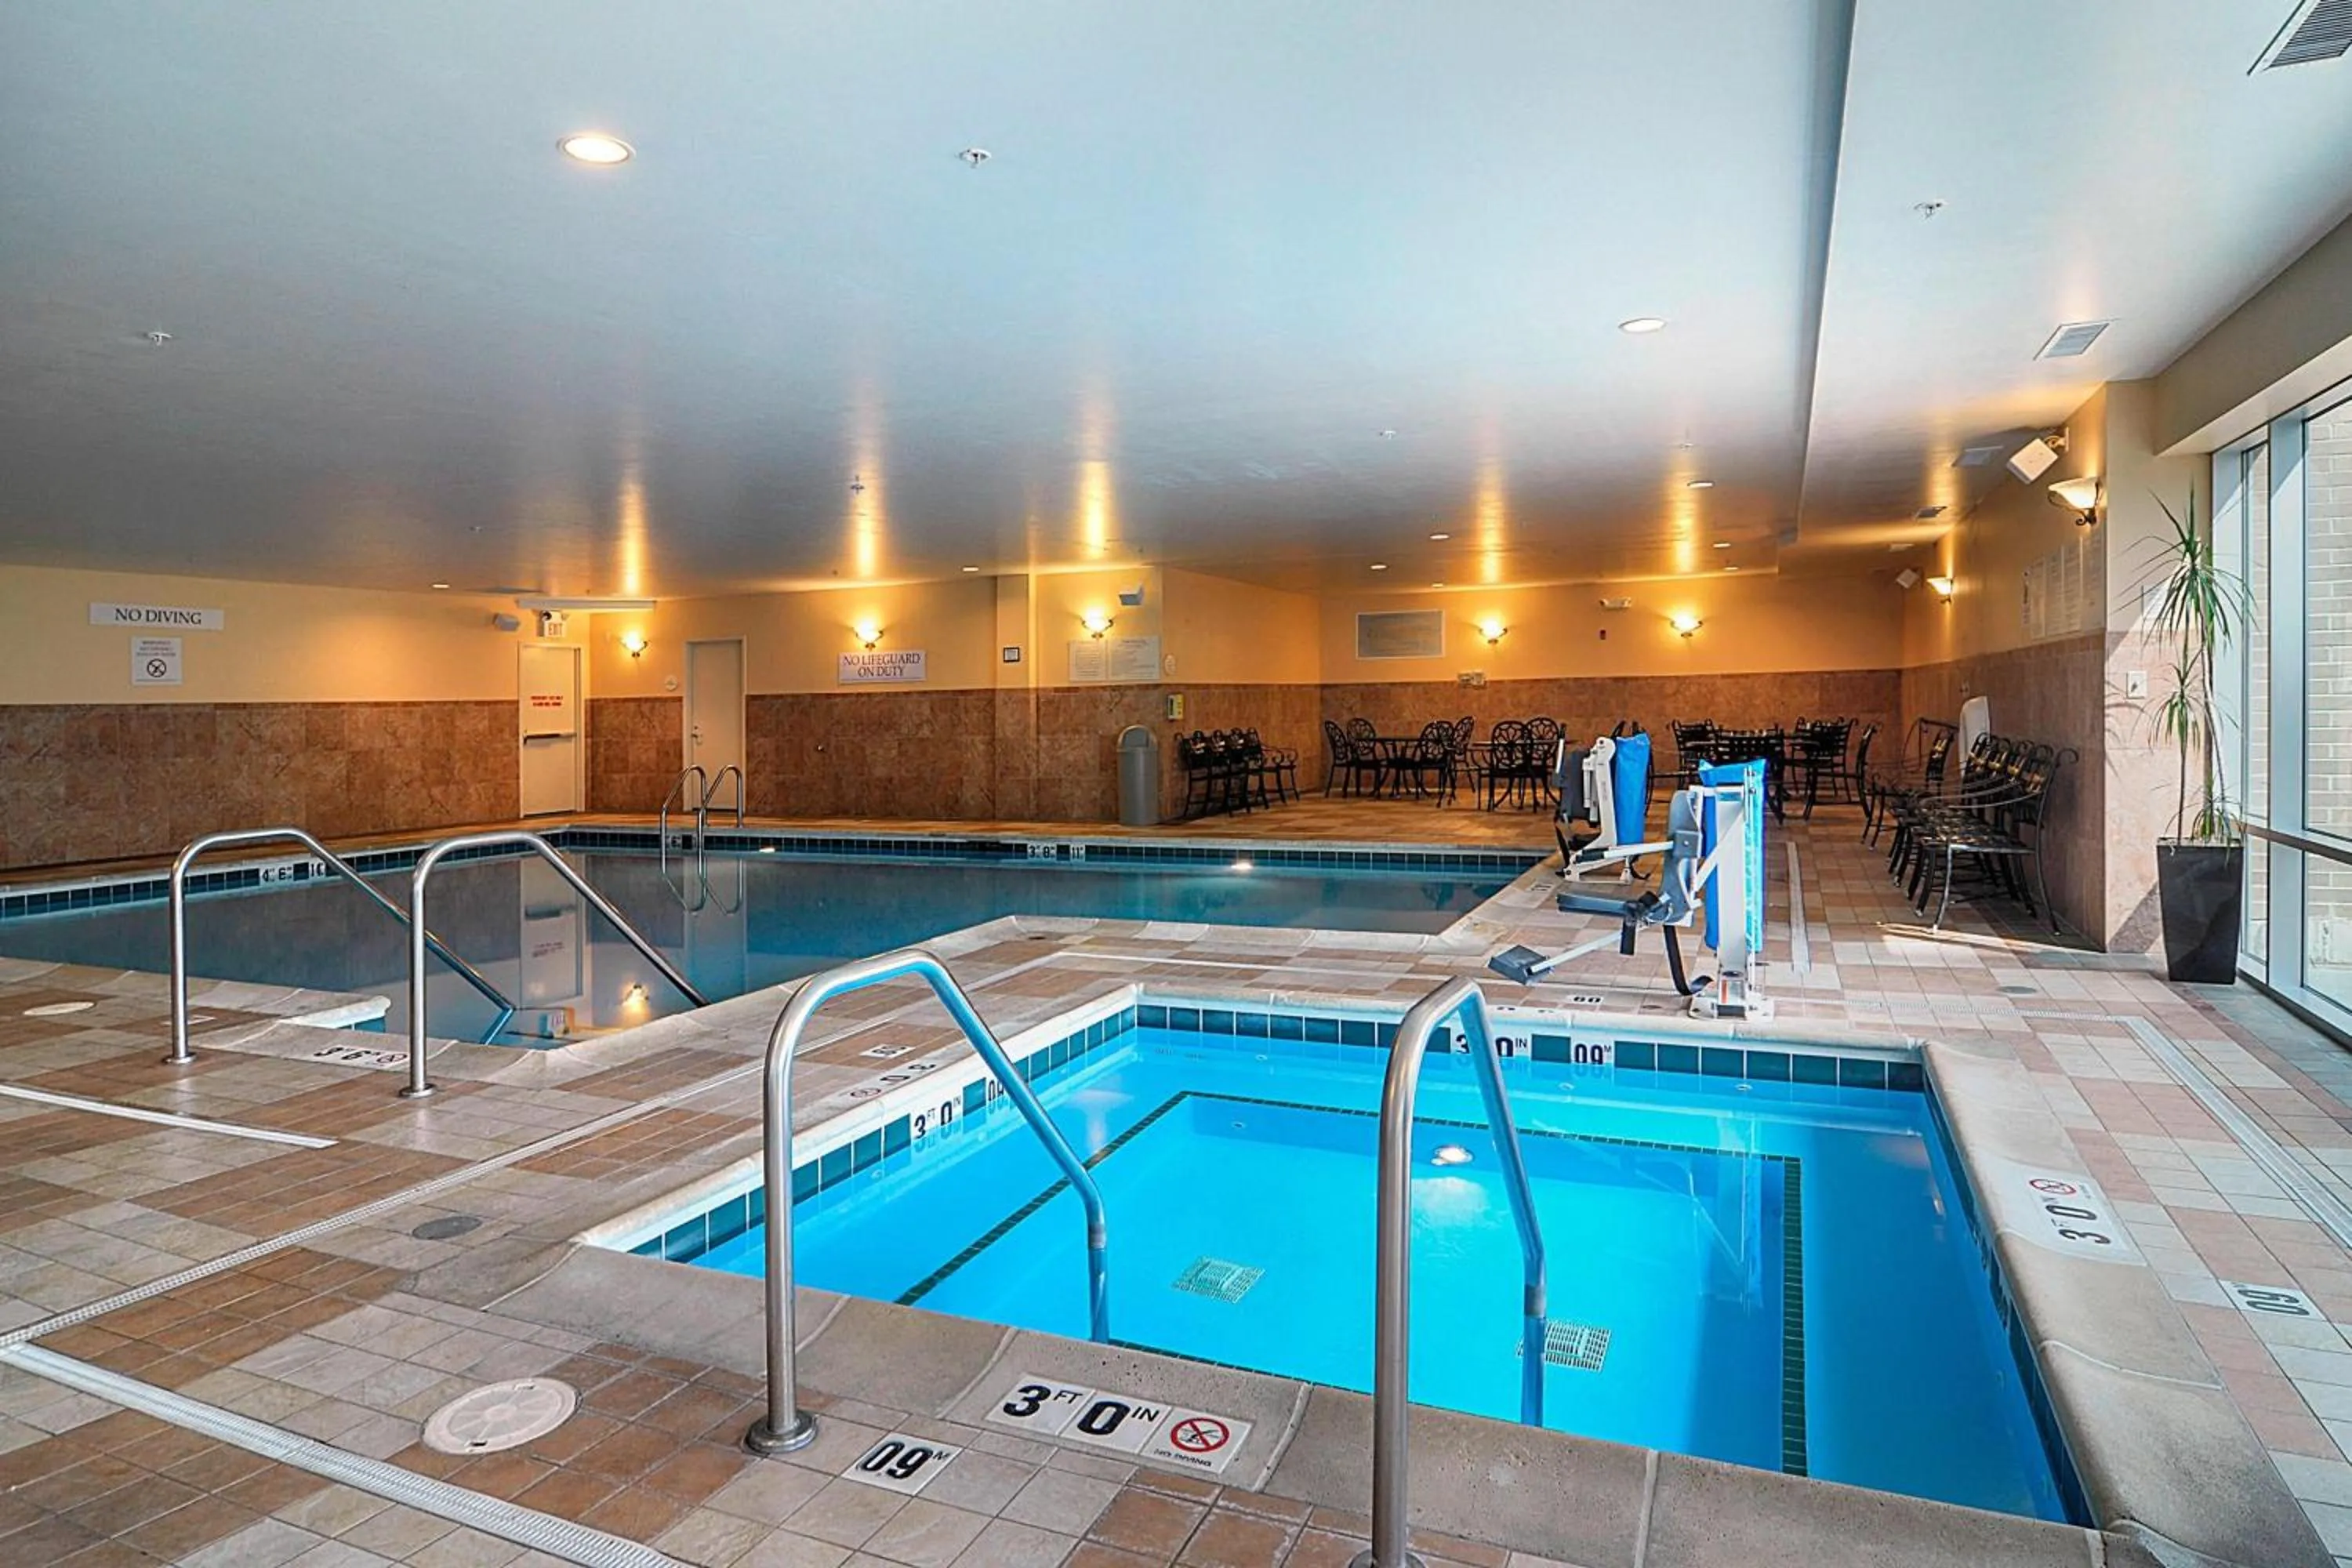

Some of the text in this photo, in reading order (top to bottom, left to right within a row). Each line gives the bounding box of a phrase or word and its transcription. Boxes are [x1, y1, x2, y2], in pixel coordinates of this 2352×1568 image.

[115, 608, 201, 625] NO DIVING
[842, 653, 921, 666] NO LIFEGUARD
[858, 665, 905, 677] ON DUTY
[1515, 1037, 1528, 1049] IN
[913, 1114, 927, 1139] 3
[941, 1101, 953, 1126] 0
[1003, 1385, 1160, 1436] 3 FT 0 IN
[1154, 1448, 1171, 1457] NO
